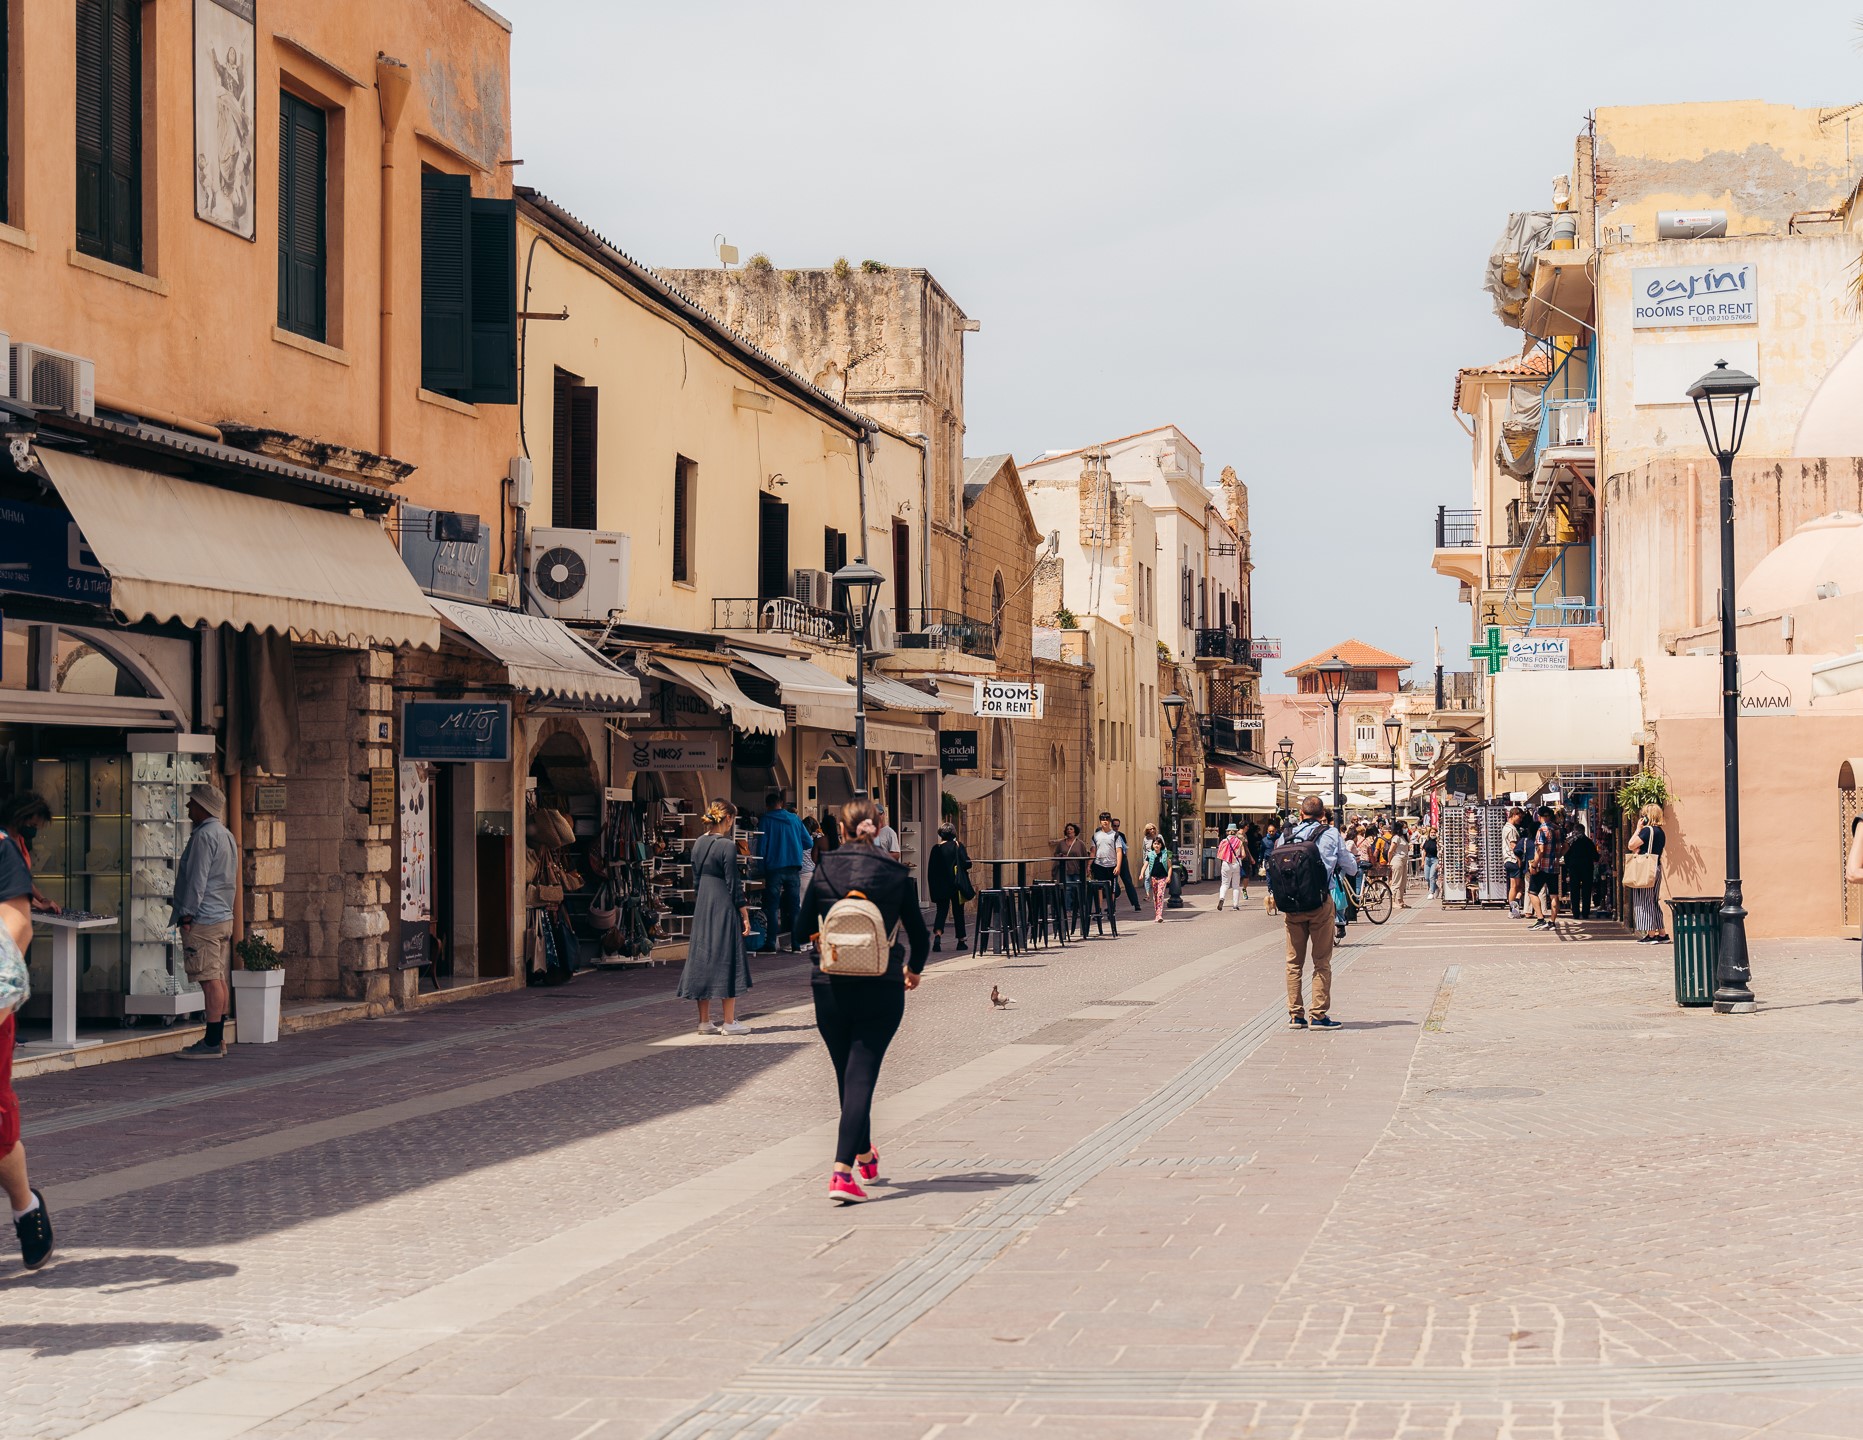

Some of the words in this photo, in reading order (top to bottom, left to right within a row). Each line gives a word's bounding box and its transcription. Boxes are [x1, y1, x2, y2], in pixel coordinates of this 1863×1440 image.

[1647, 266, 1749, 300] earini
[1636, 305, 1684, 318] ROOMS
[1688, 304, 1715, 316] FOR
[1719, 303, 1753, 315] RENT
[1731, 313, 1751, 321] 57666
[1512, 639, 1565, 655] earini
[982, 687, 1039, 701] ROOMS
[981, 700, 1002, 711] FOR
[1006, 701, 1033, 713] RENT
[380, 724, 388, 737] 46
[440, 708, 499, 742] Mitos
[1240, 720, 1262, 728] favela
[652, 747, 684, 761] NIKOS
[941, 745, 976, 756] sandali
